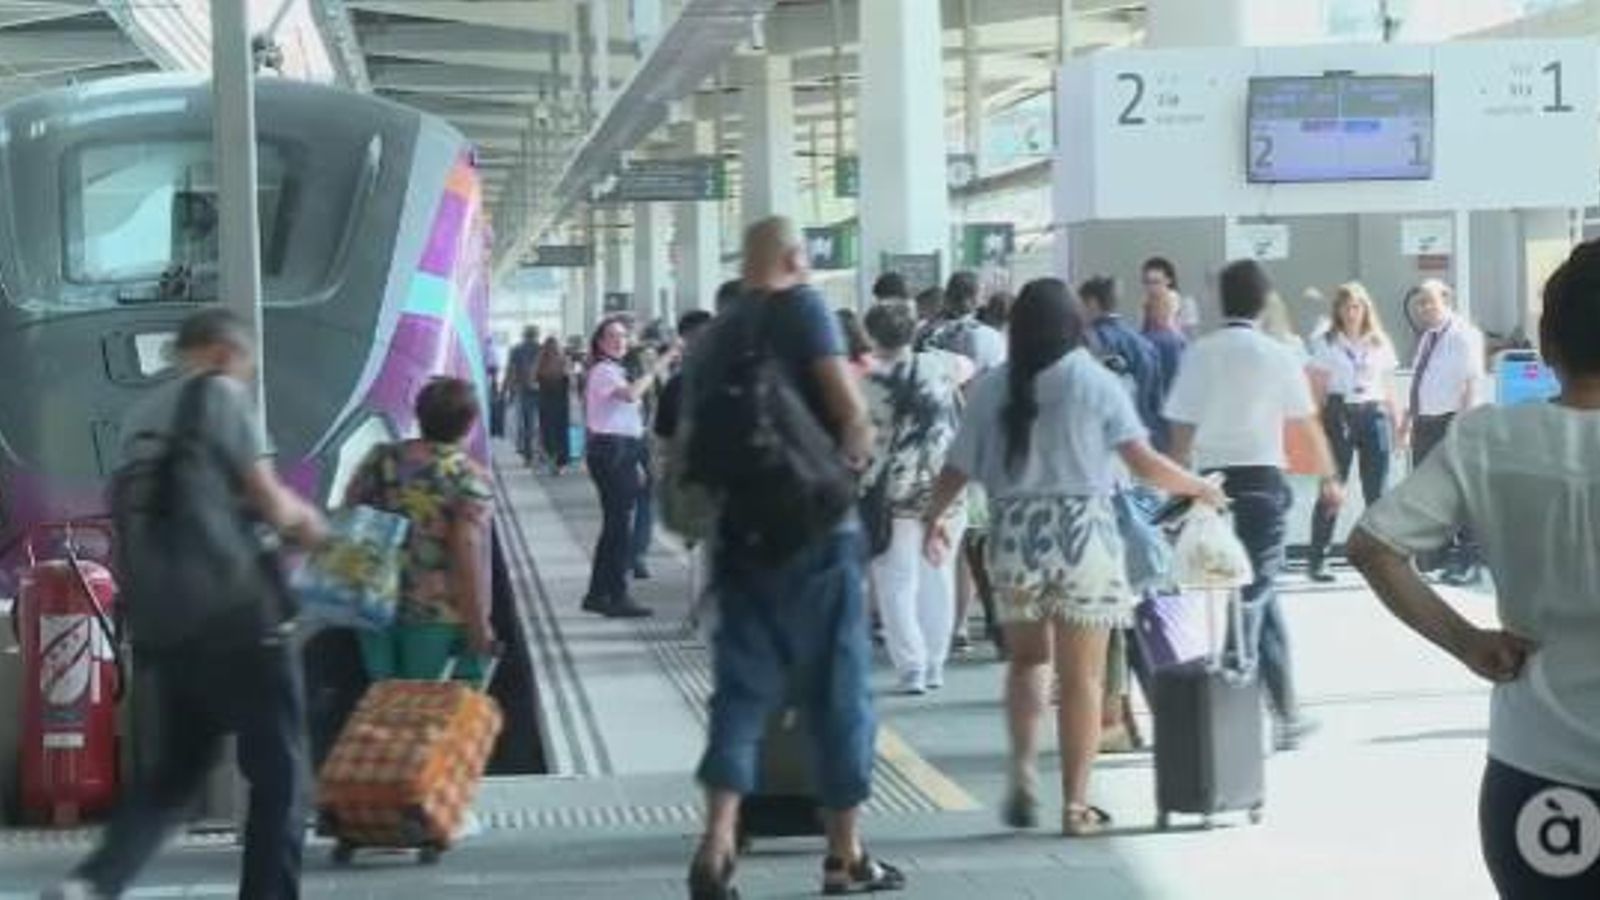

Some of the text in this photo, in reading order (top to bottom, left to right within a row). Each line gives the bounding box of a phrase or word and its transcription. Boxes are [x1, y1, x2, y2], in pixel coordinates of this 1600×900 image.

[1117, 73, 1145, 125] 2
[1541, 61, 1574, 112] 1
[1254, 135, 1274, 168] 2
[1407, 132, 1426, 166] 1
